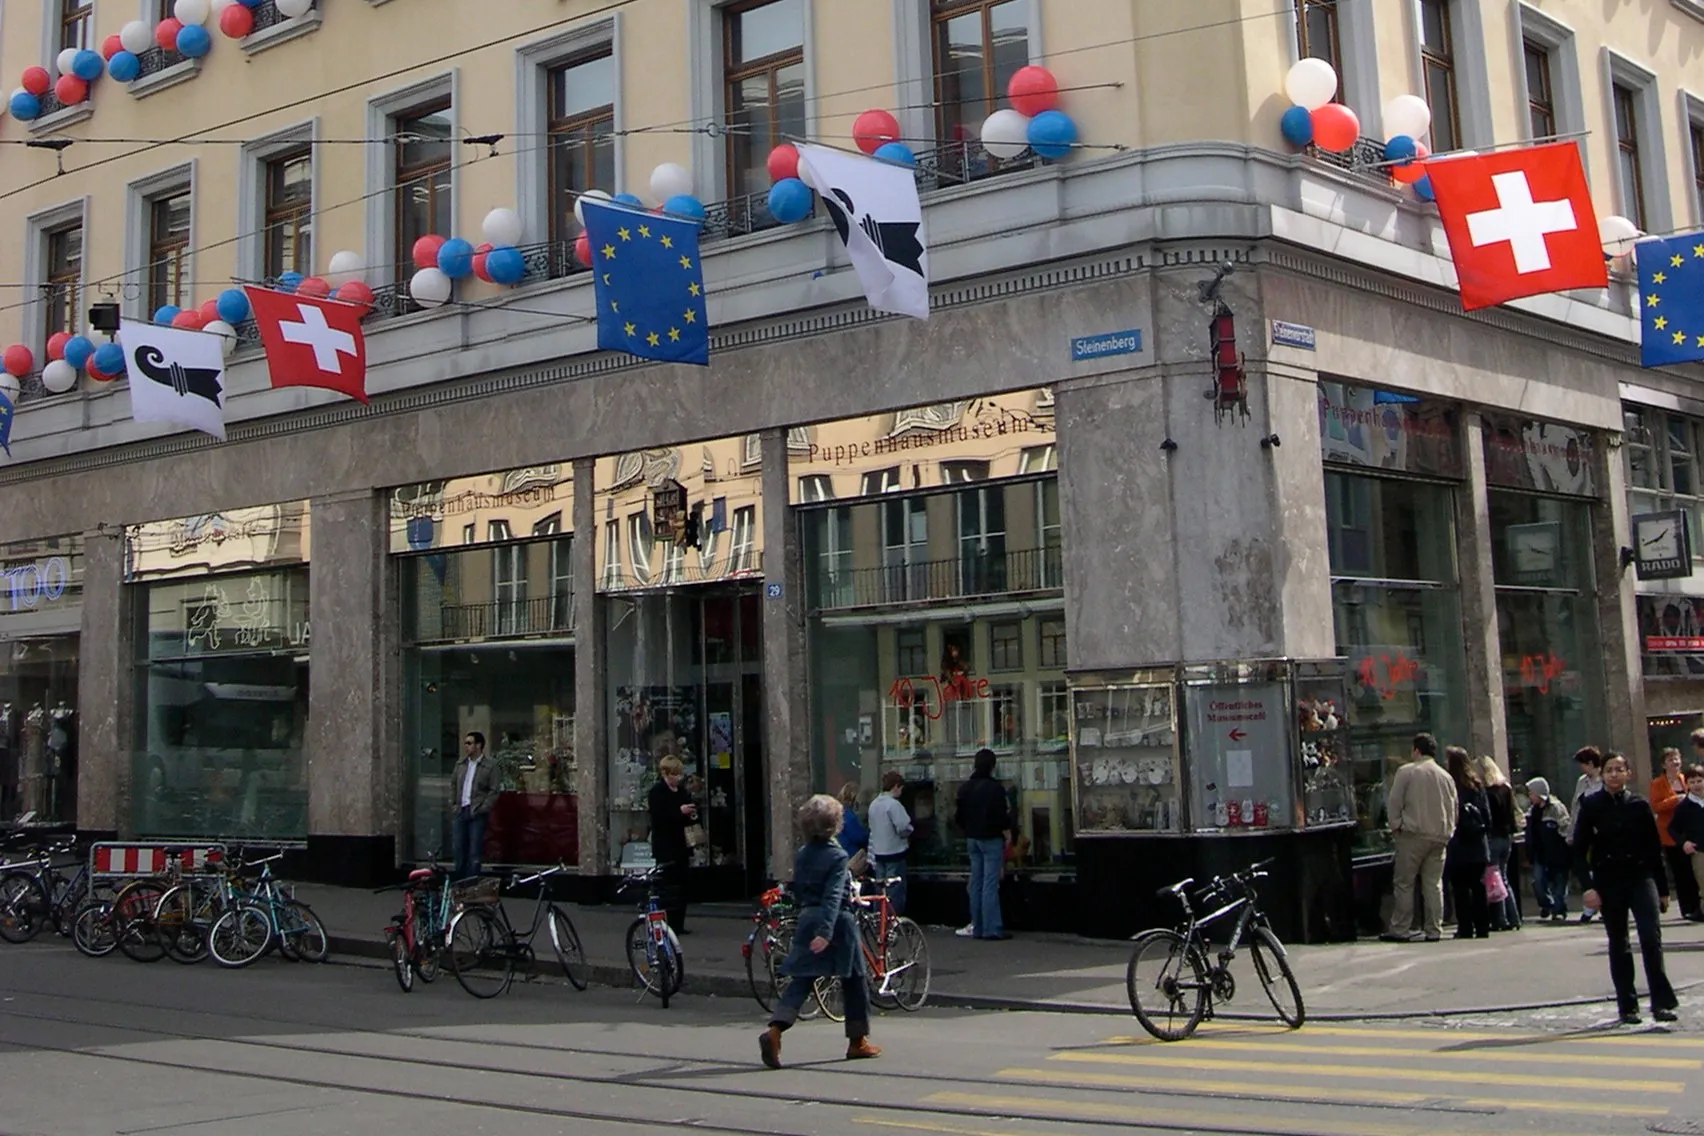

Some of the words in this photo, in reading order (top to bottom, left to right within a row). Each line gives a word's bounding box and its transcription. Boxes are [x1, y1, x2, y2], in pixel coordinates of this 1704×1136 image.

[1076, 336, 1136, 355] Steinenberg
[808, 416, 1029, 464] Puppenhausmuseum
[1641, 558, 1681, 572] RADO
[889, 677, 914, 708] 10
[921, 674, 991, 720] Jahre
